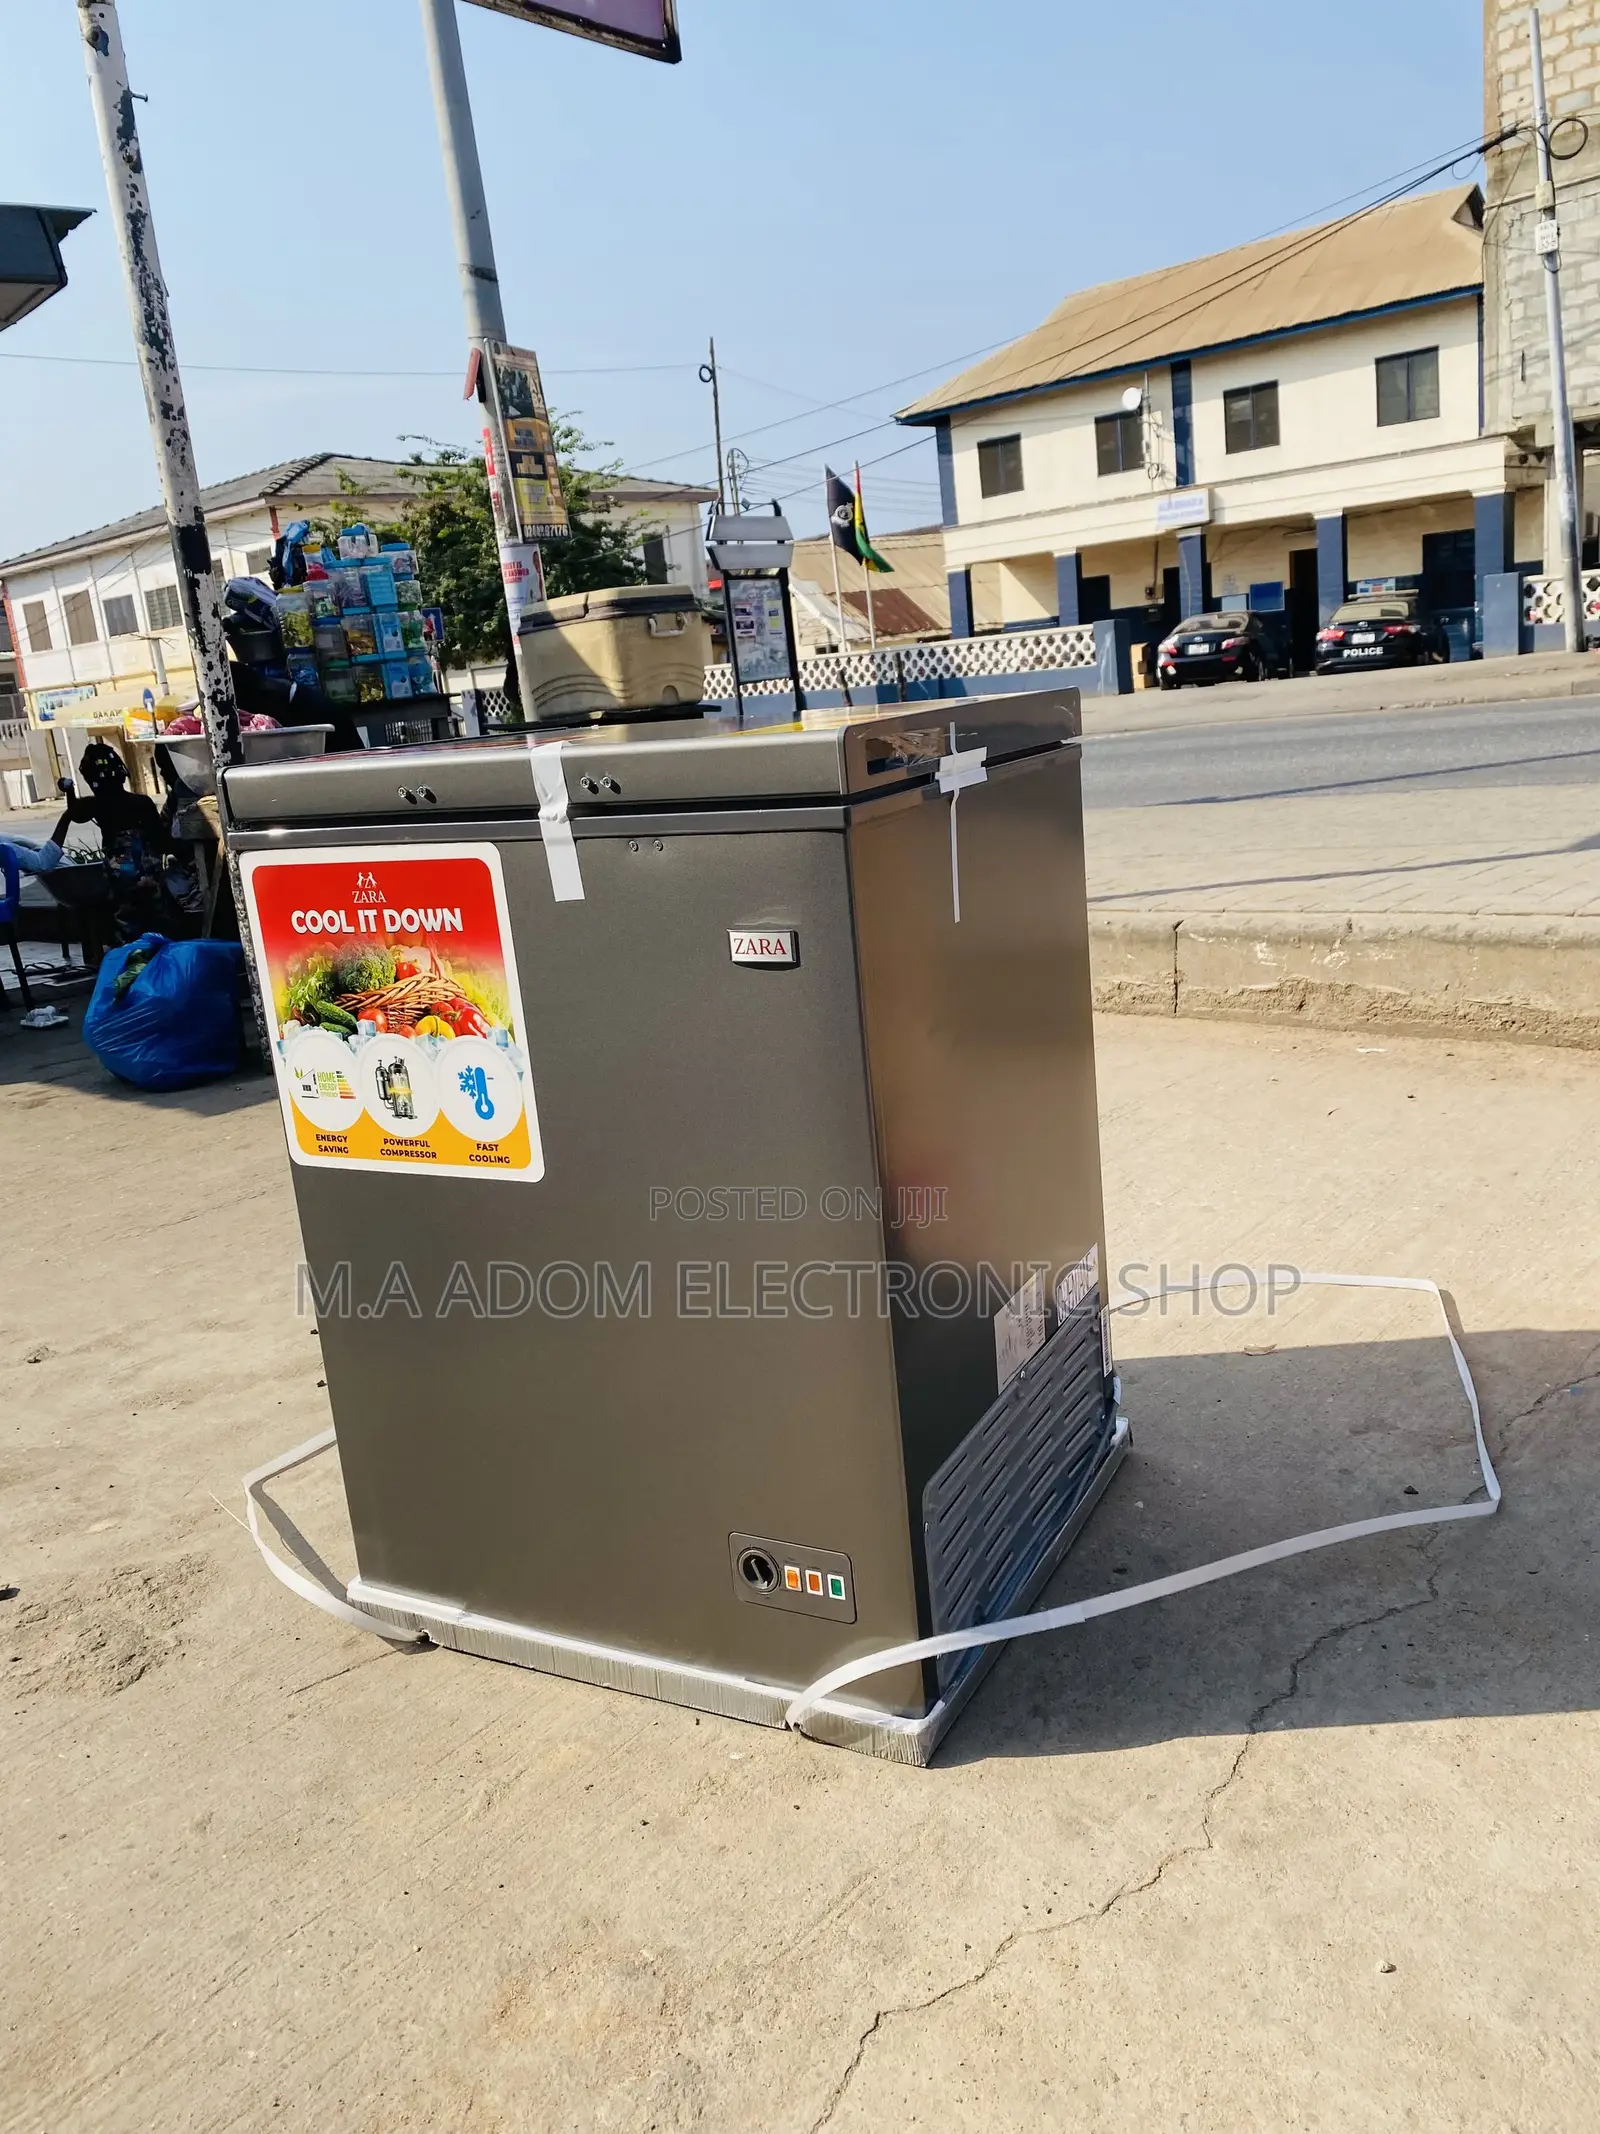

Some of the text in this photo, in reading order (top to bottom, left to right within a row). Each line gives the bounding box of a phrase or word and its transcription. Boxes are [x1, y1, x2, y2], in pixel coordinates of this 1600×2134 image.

[1342, 646, 1383, 658] POLICE
[351, 890, 387, 904] ZARA
[291, 908, 463, 934] COOL IT DOWN
[733, 938, 787, 955] ZARA
[316, 1071, 337, 1083] HOME
[318, 1082, 338, 1091] ENERGY
[315, 1133, 348, 1144] ENERGY
[383, 1138, 431, 1149] POWERFUL
[318, 1144, 349, 1154] SAVING
[476, 1143, 499, 1152] FAST
[380, 1148, 437, 1160] COMPRESSOR
[468, 1153, 511, 1164] COOLING
